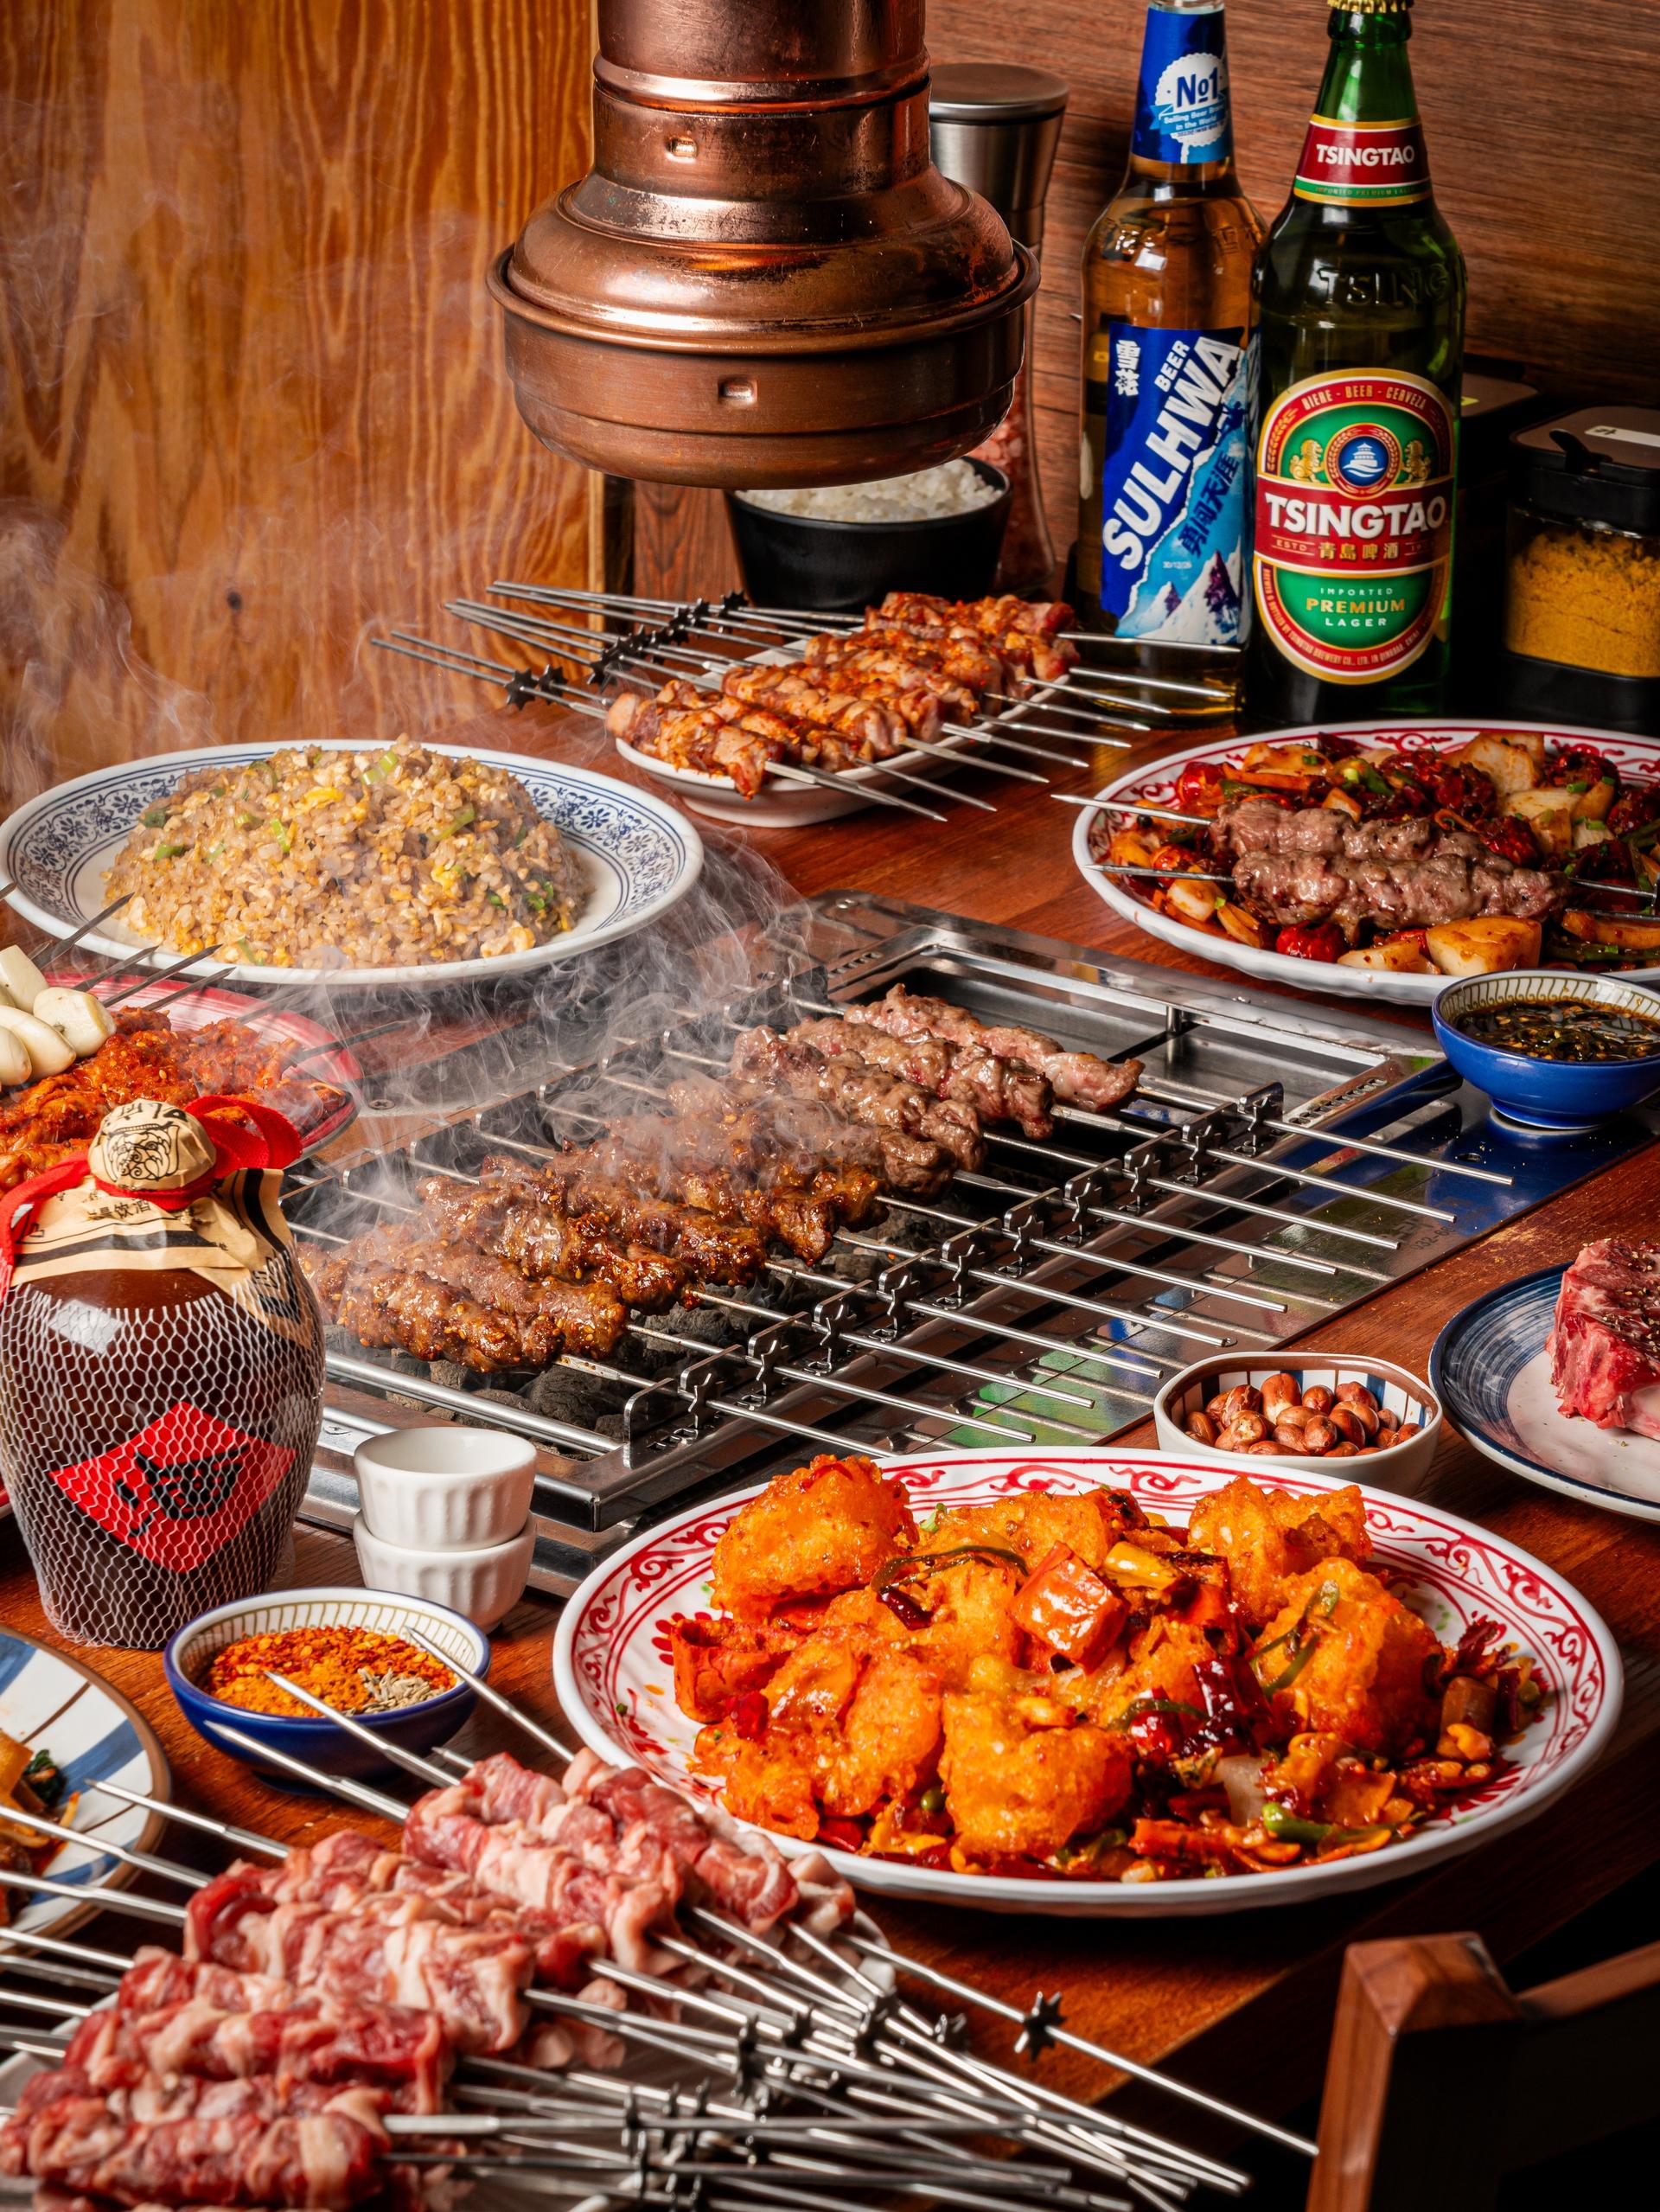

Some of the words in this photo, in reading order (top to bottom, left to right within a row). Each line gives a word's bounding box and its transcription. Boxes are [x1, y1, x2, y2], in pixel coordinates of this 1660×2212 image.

[1316, 144, 1414, 167] TSINGTAO
[1153, 340, 1191, 393] BEER
[1301, 389, 1333, 411] BIERE
[1345, 385, 1374, 399] BEER
[1385, 387, 1427, 410] CERVEZA
[1102, 336, 1241, 571] SULHWA
[1265, 492, 1446, 539] TSINGTAO
[1276, 539, 1307, 552] ESTD
[1320, 587, 1393, 596] IMPORTED
[1306, 598, 1405, 614] PREMIUM
[1325, 617, 1387, 627] LAGER
[1313, 647, 1342, 665] BREWERY
